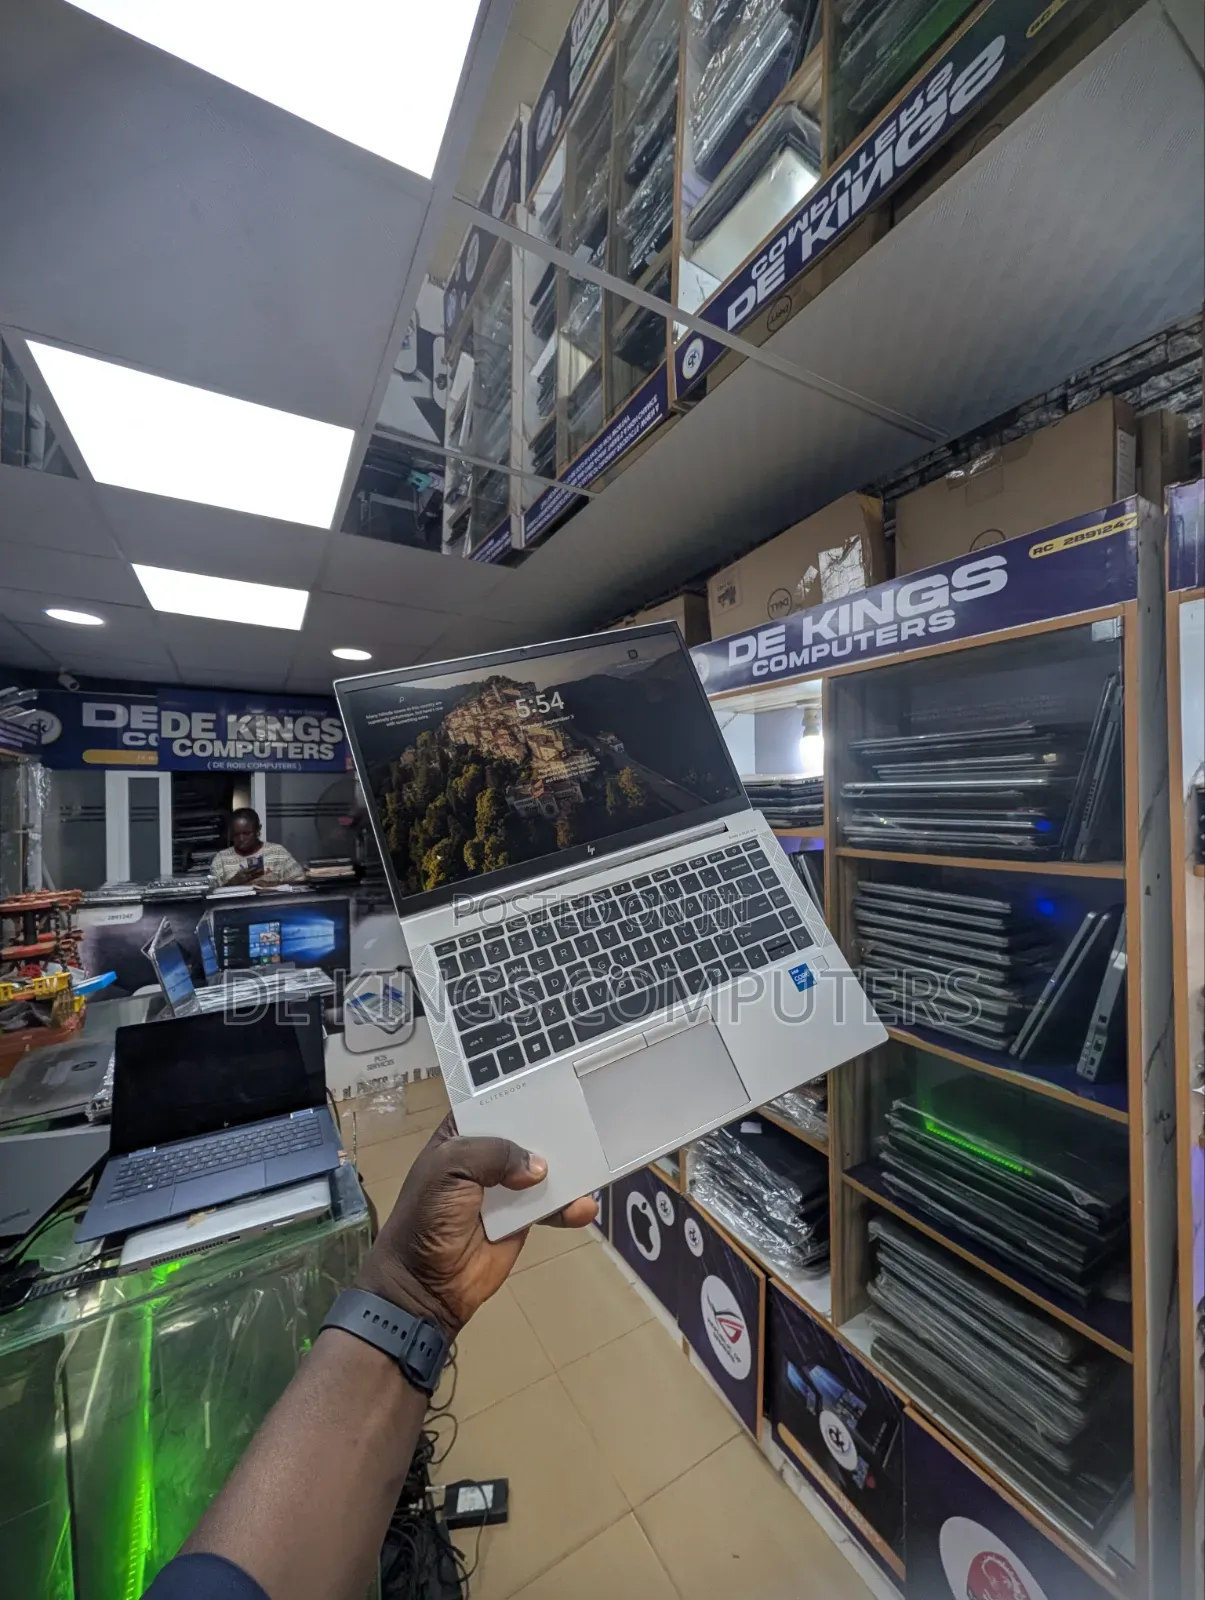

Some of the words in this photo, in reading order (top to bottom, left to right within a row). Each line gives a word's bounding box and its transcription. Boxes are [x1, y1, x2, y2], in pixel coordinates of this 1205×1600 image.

[1032, 543, 1054, 556] RC
[728, 624, 786, 667] DE
[802, 555, 1008, 647] KINGS
[752, 609, 955, 677] COMPUTERS
[515, 691, 565, 718] 5:54
[82, 702, 158, 730] DE
[161, 710, 217, 740] DE
[227, 714, 343, 744] KINGS
[172, 738, 335, 761] COMPUTERS
[536, 956, 545, 966] E
[559, 948, 568, 957] R
[510, 964, 522, 974] W
[597, 960, 606, 970] G
[550, 978, 559, 988] D
[547, 1006, 557, 1016] X
[479, 1081, 527, 1106] ELITEBOOK
